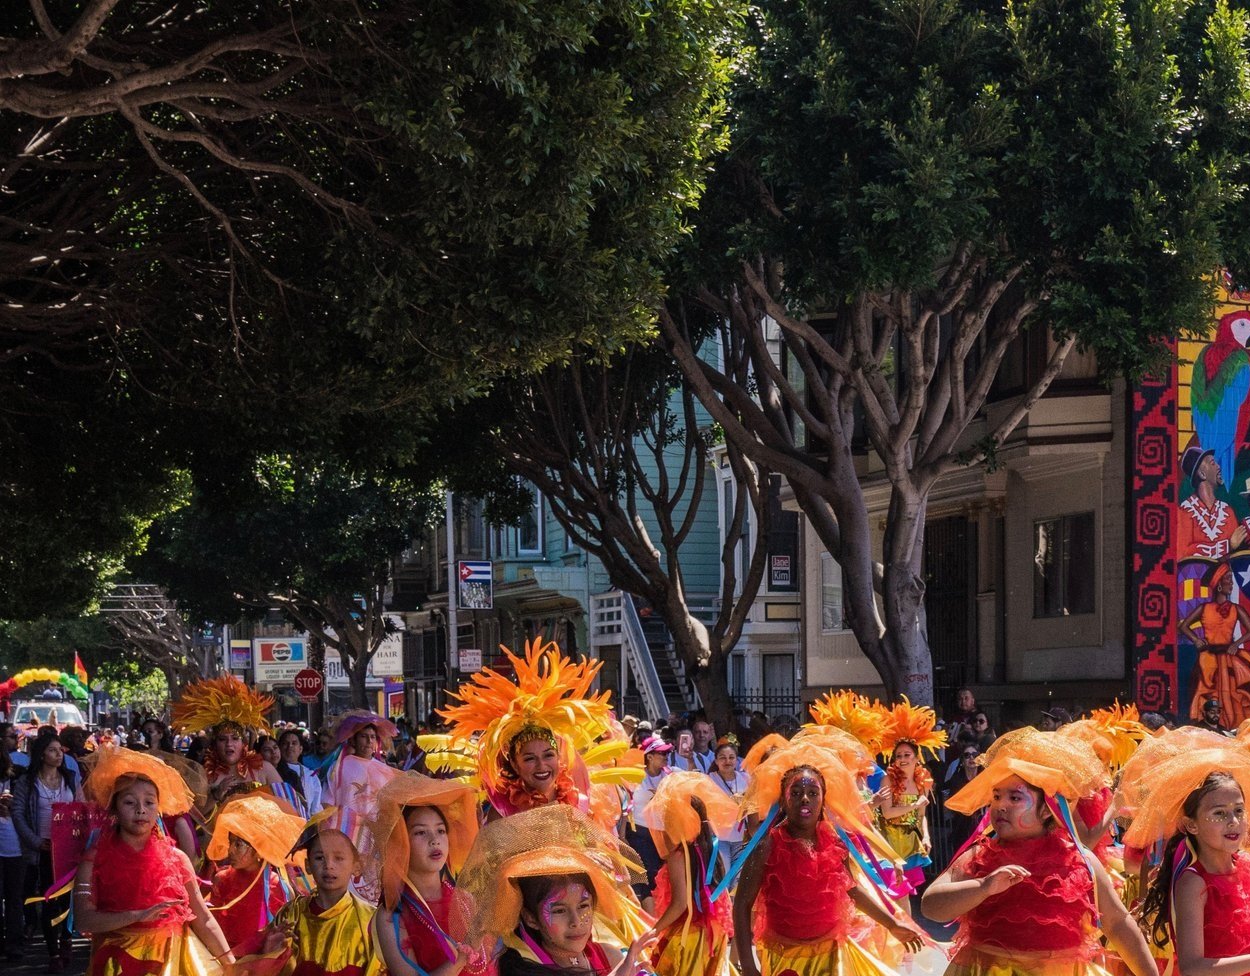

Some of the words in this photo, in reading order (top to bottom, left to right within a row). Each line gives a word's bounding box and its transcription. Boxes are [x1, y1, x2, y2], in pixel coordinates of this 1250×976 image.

[773, 557, 789, 567] Jane
[773, 570, 788, 580] Kim
[376, 651, 398, 659] HAIR
[296, 677, 321, 689] STOP
